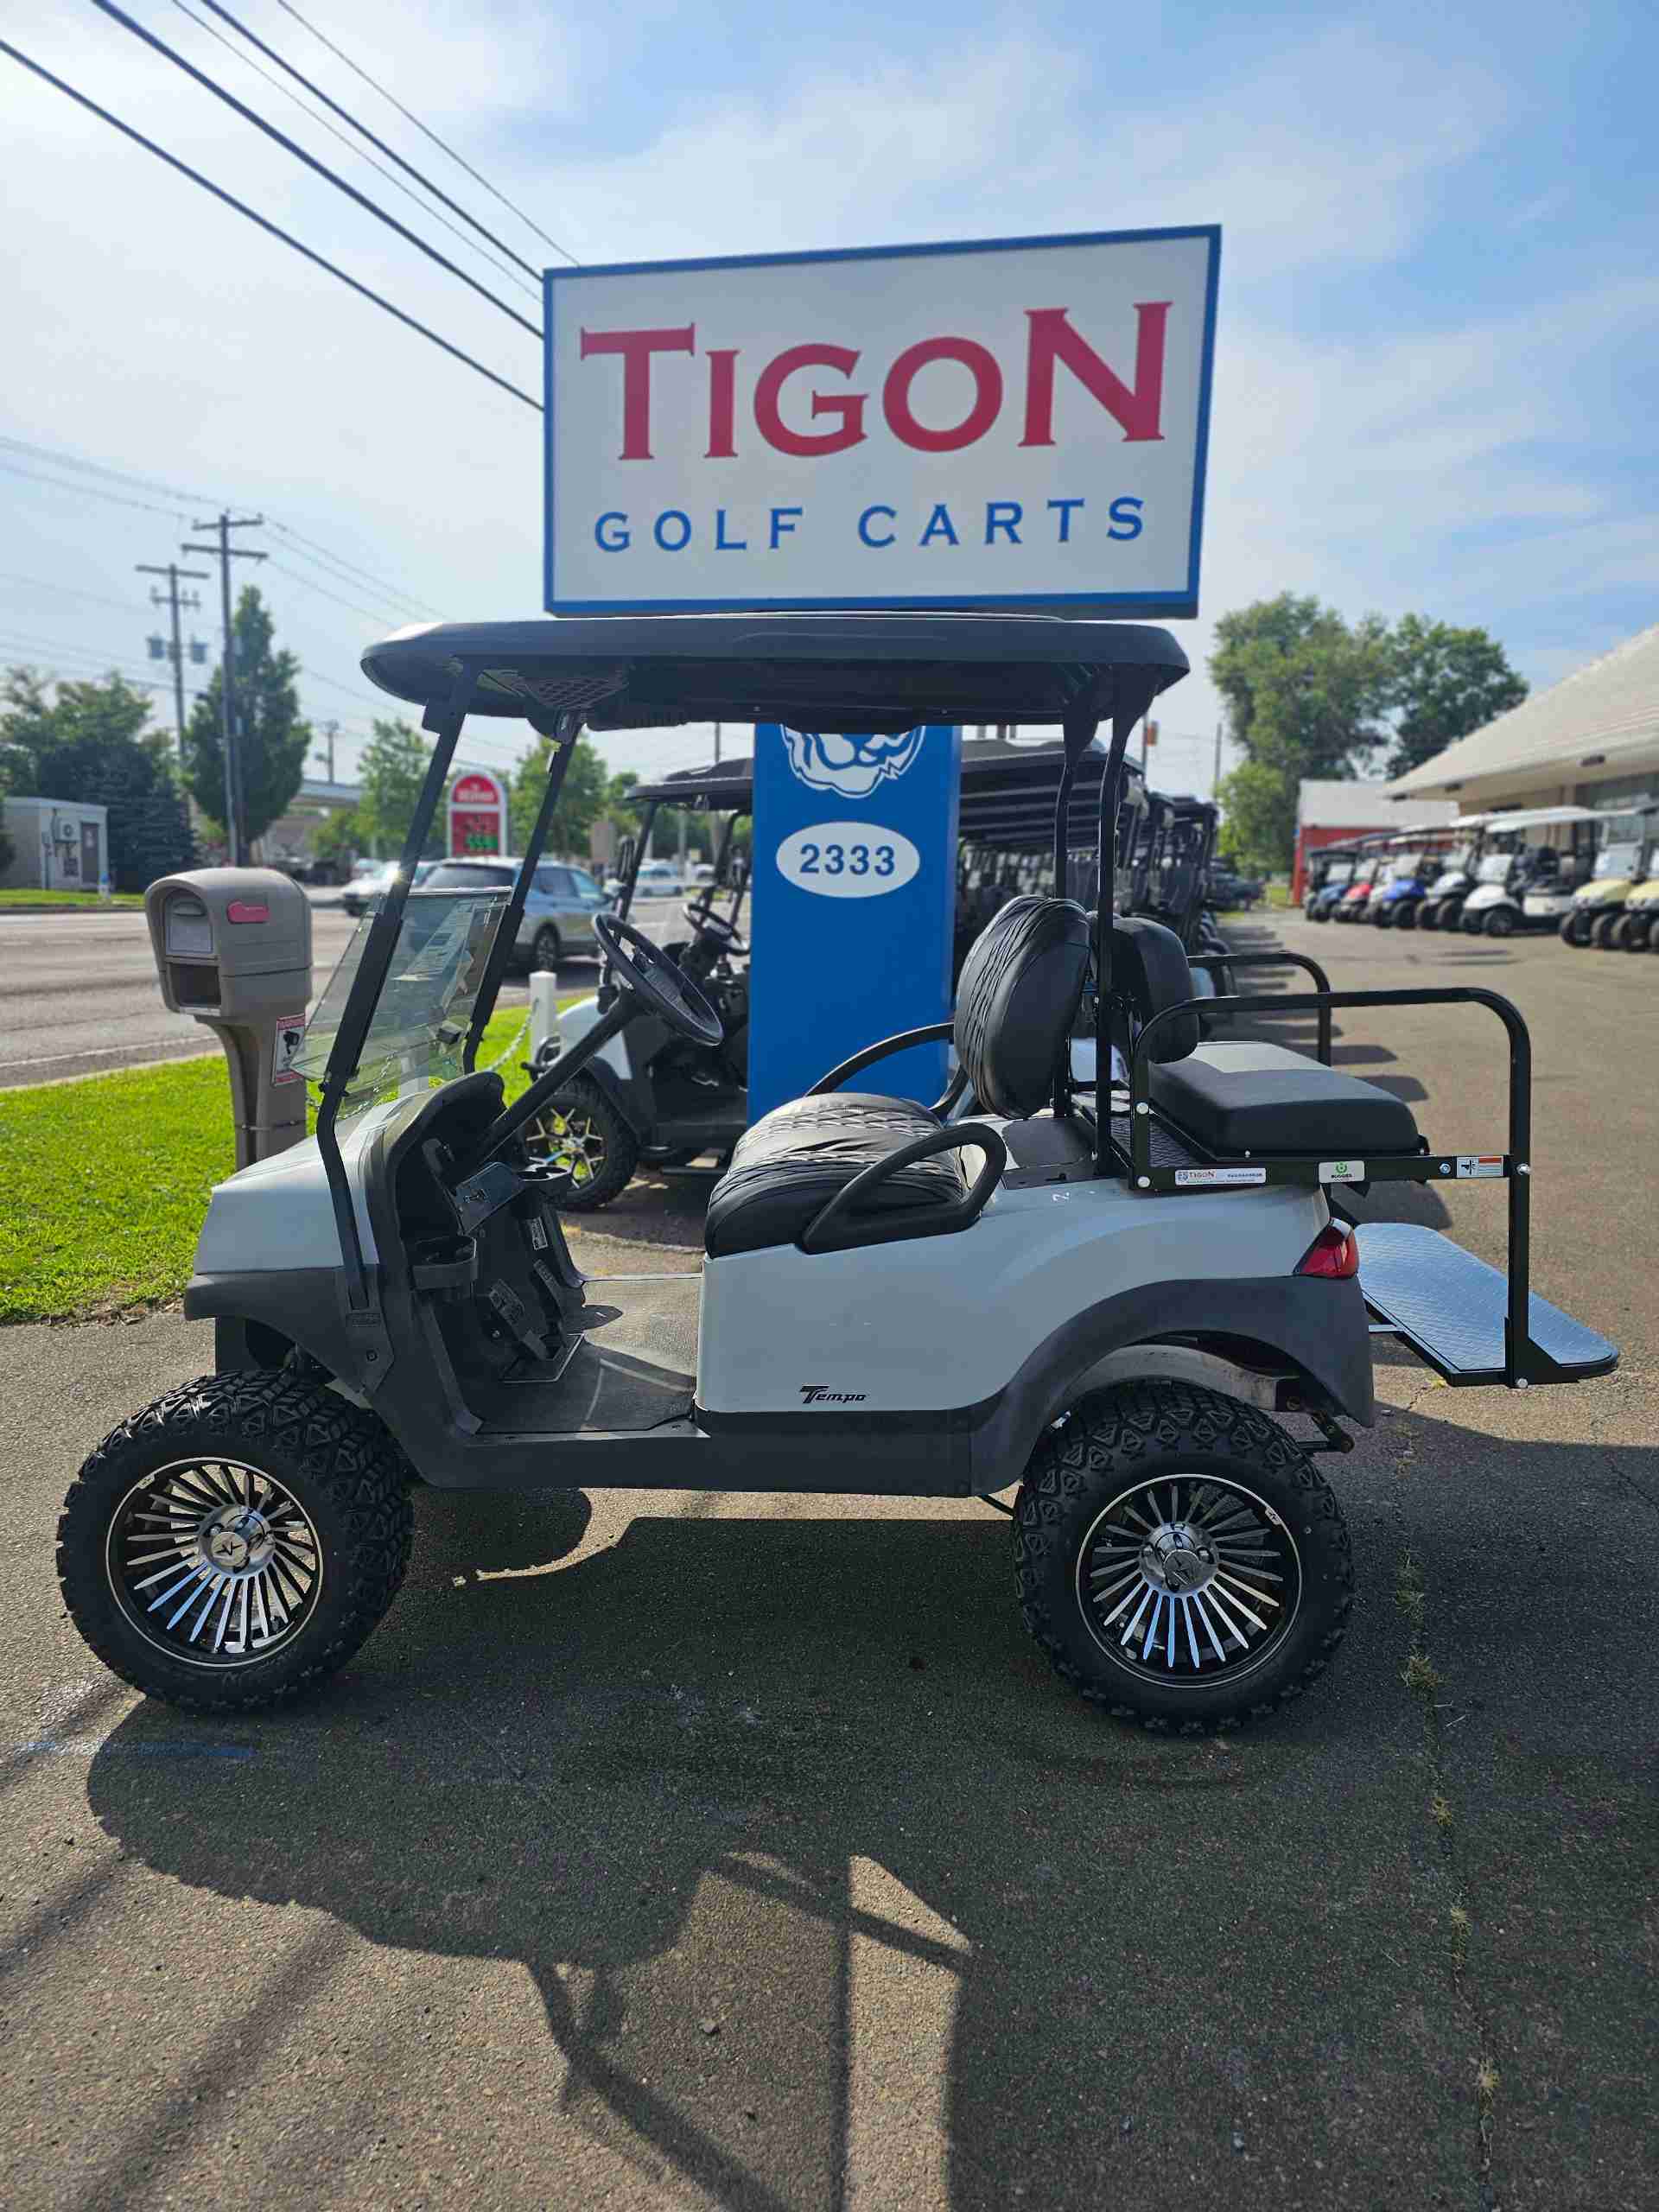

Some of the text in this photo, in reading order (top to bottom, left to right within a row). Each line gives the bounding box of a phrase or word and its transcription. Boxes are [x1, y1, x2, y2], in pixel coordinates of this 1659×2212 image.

[580, 302, 1173, 460] TIGON
[594, 496, 1145, 553] GOLF CARTS
[799, 843, 895, 876] 2333
[799, 1385, 867, 1404] Tempo
